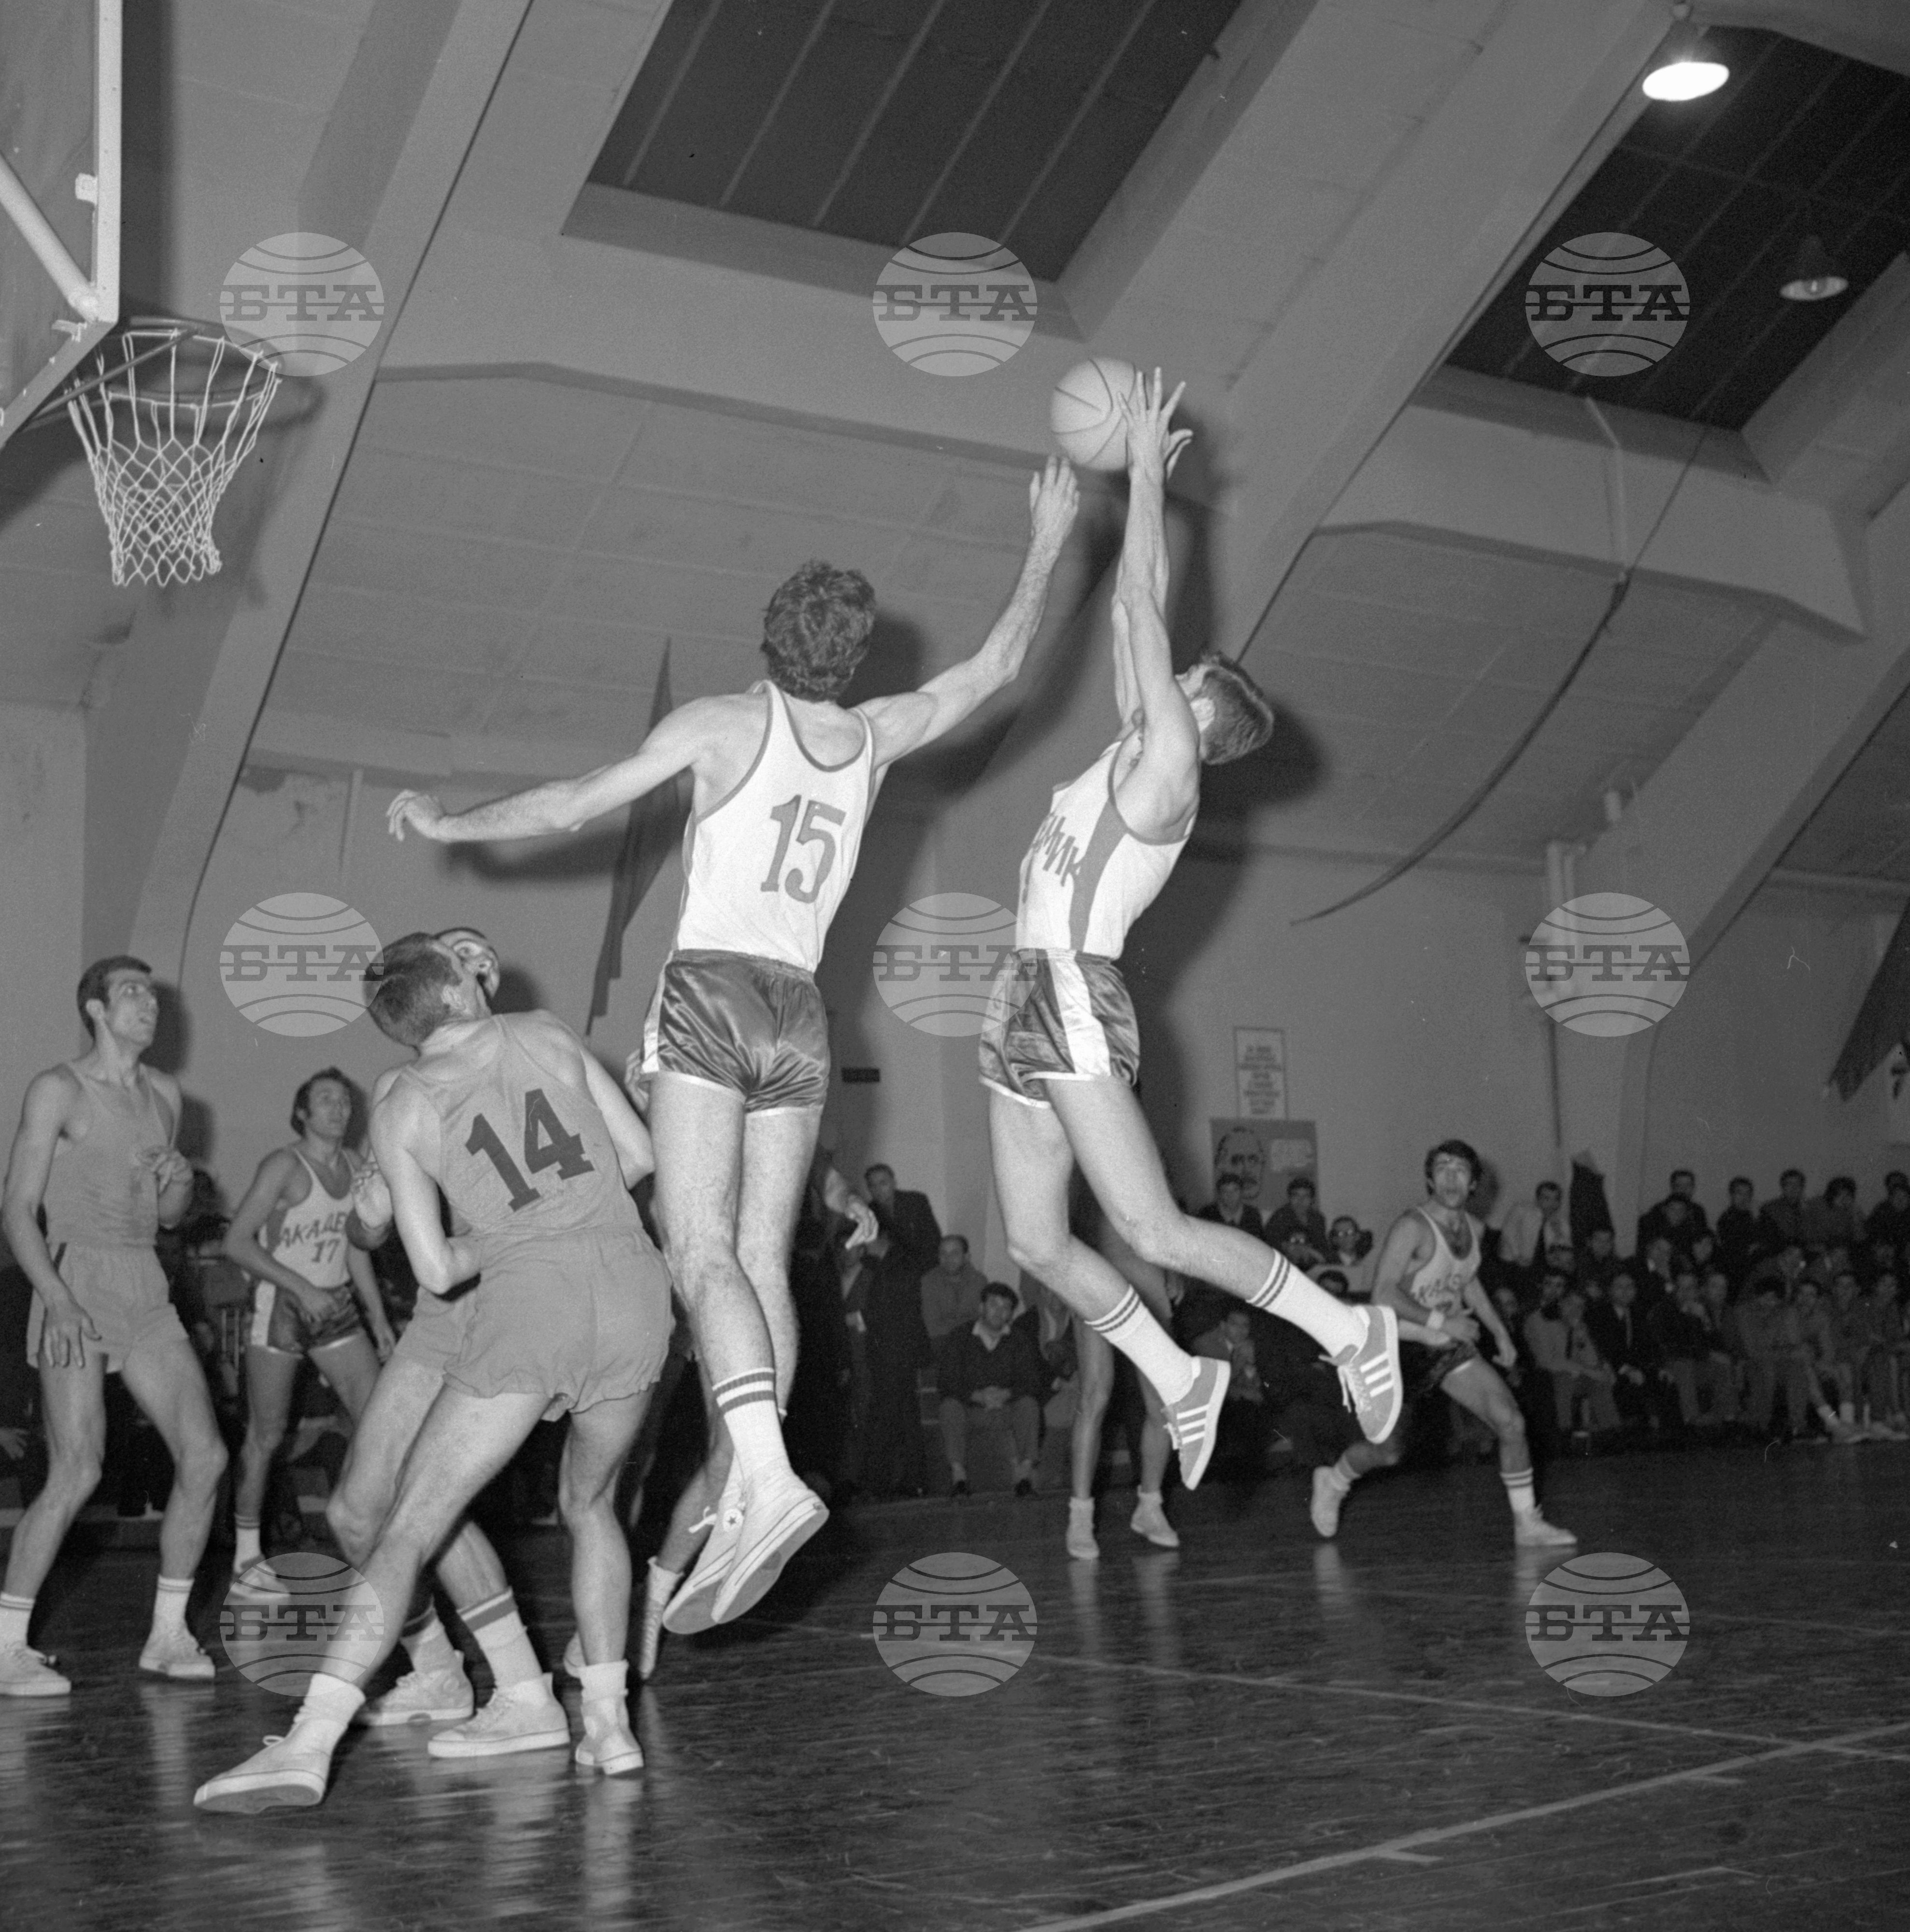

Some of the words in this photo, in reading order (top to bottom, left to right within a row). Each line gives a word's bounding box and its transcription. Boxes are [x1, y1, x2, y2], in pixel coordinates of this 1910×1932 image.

[760, 794, 847, 904] 15
[465, 1088, 595, 1212] 14
[312, 1238, 342, 1263] 17
